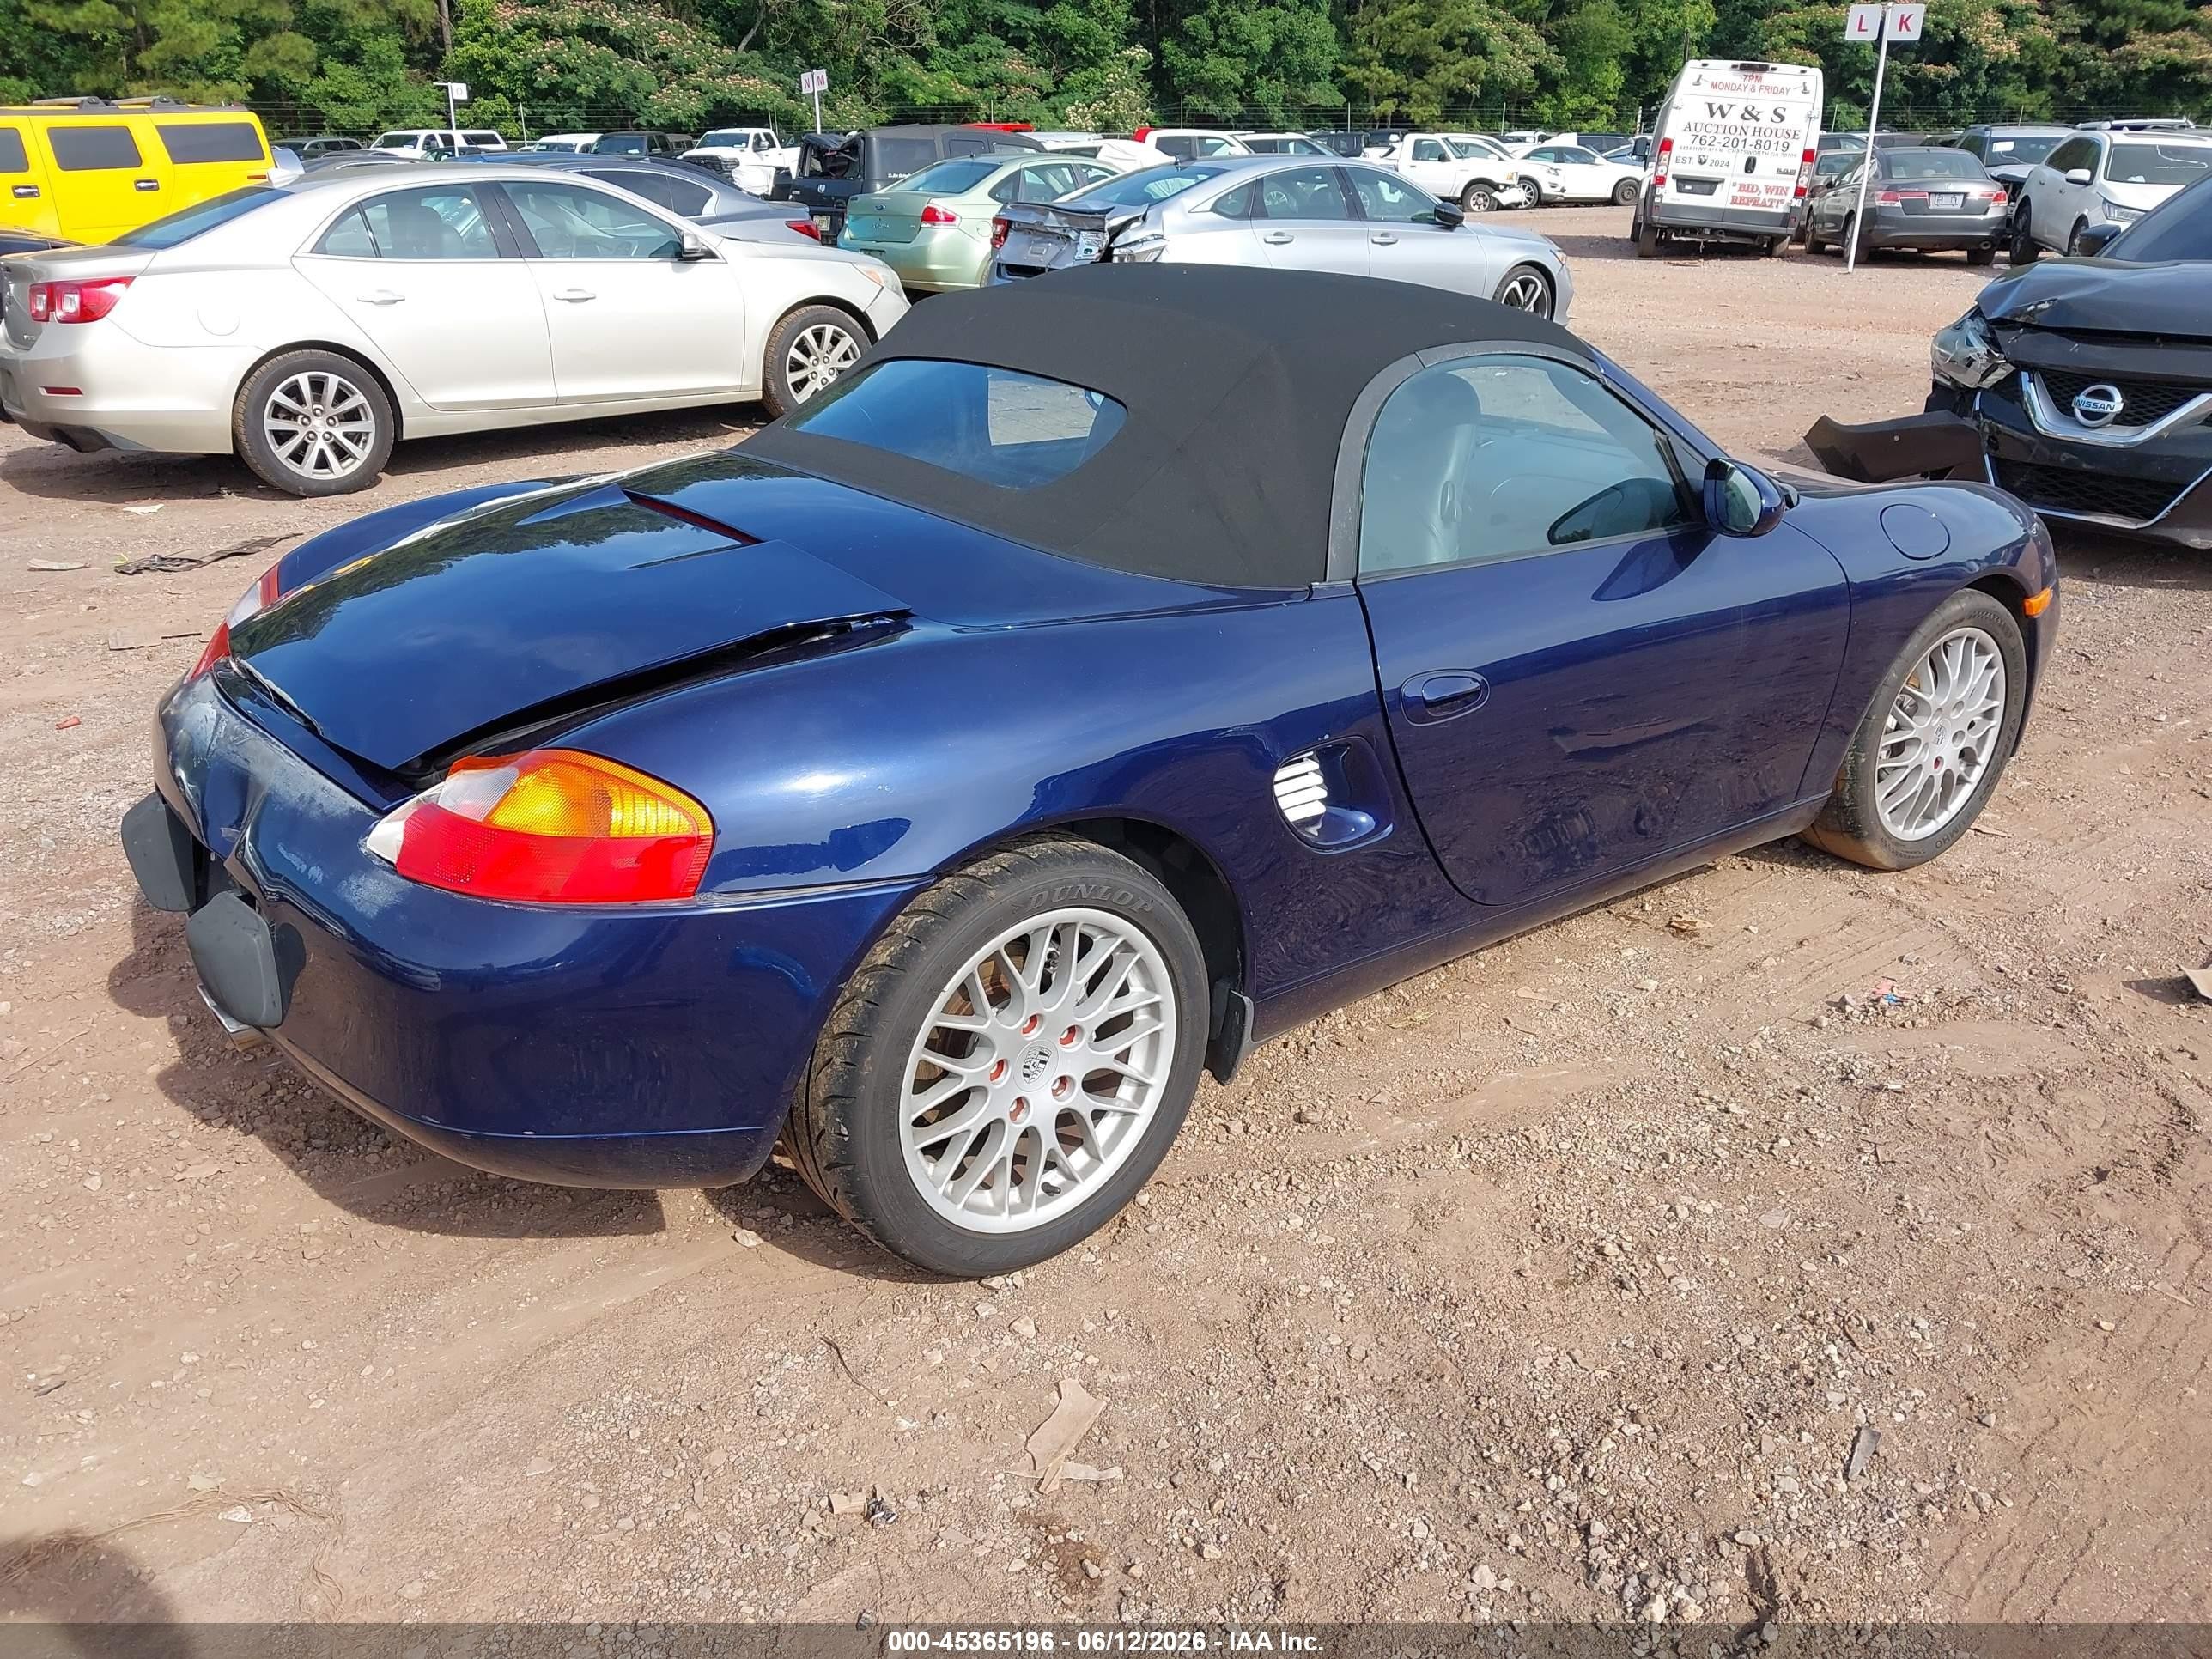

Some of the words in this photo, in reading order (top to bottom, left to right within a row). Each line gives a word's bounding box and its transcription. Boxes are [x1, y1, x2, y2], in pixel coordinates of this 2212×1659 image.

[1857, 14, 1868, 33] L
[1899, 13, 1914, 33] K
[805, 78, 811, 88] N
[817, 75, 825, 86] M
[1743, 74, 1763, 83] 7PM
[1711, 82, 1748, 93] MONDAY
[1759, 85, 1791, 95] FRIDAY
[1705, 102, 1736, 119] W
[1741, 105, 1764, 122] &
[1771, 106, 1786, 124] S
[1683, 121, 1749, 136] AUCTION
[1752, 126, 1801, 140] HOUSE
[1691, 134, 1790, 152] 762-201-8019
[1675, 155, 1694, 165] EST.
[1709, 159, 1729, 167] 2024
[1764, 185, 1790, 196] WIN
[2075, 398, 2115, 410] NISSAN
[1024, 884, 1154, 914] DUNLOP
